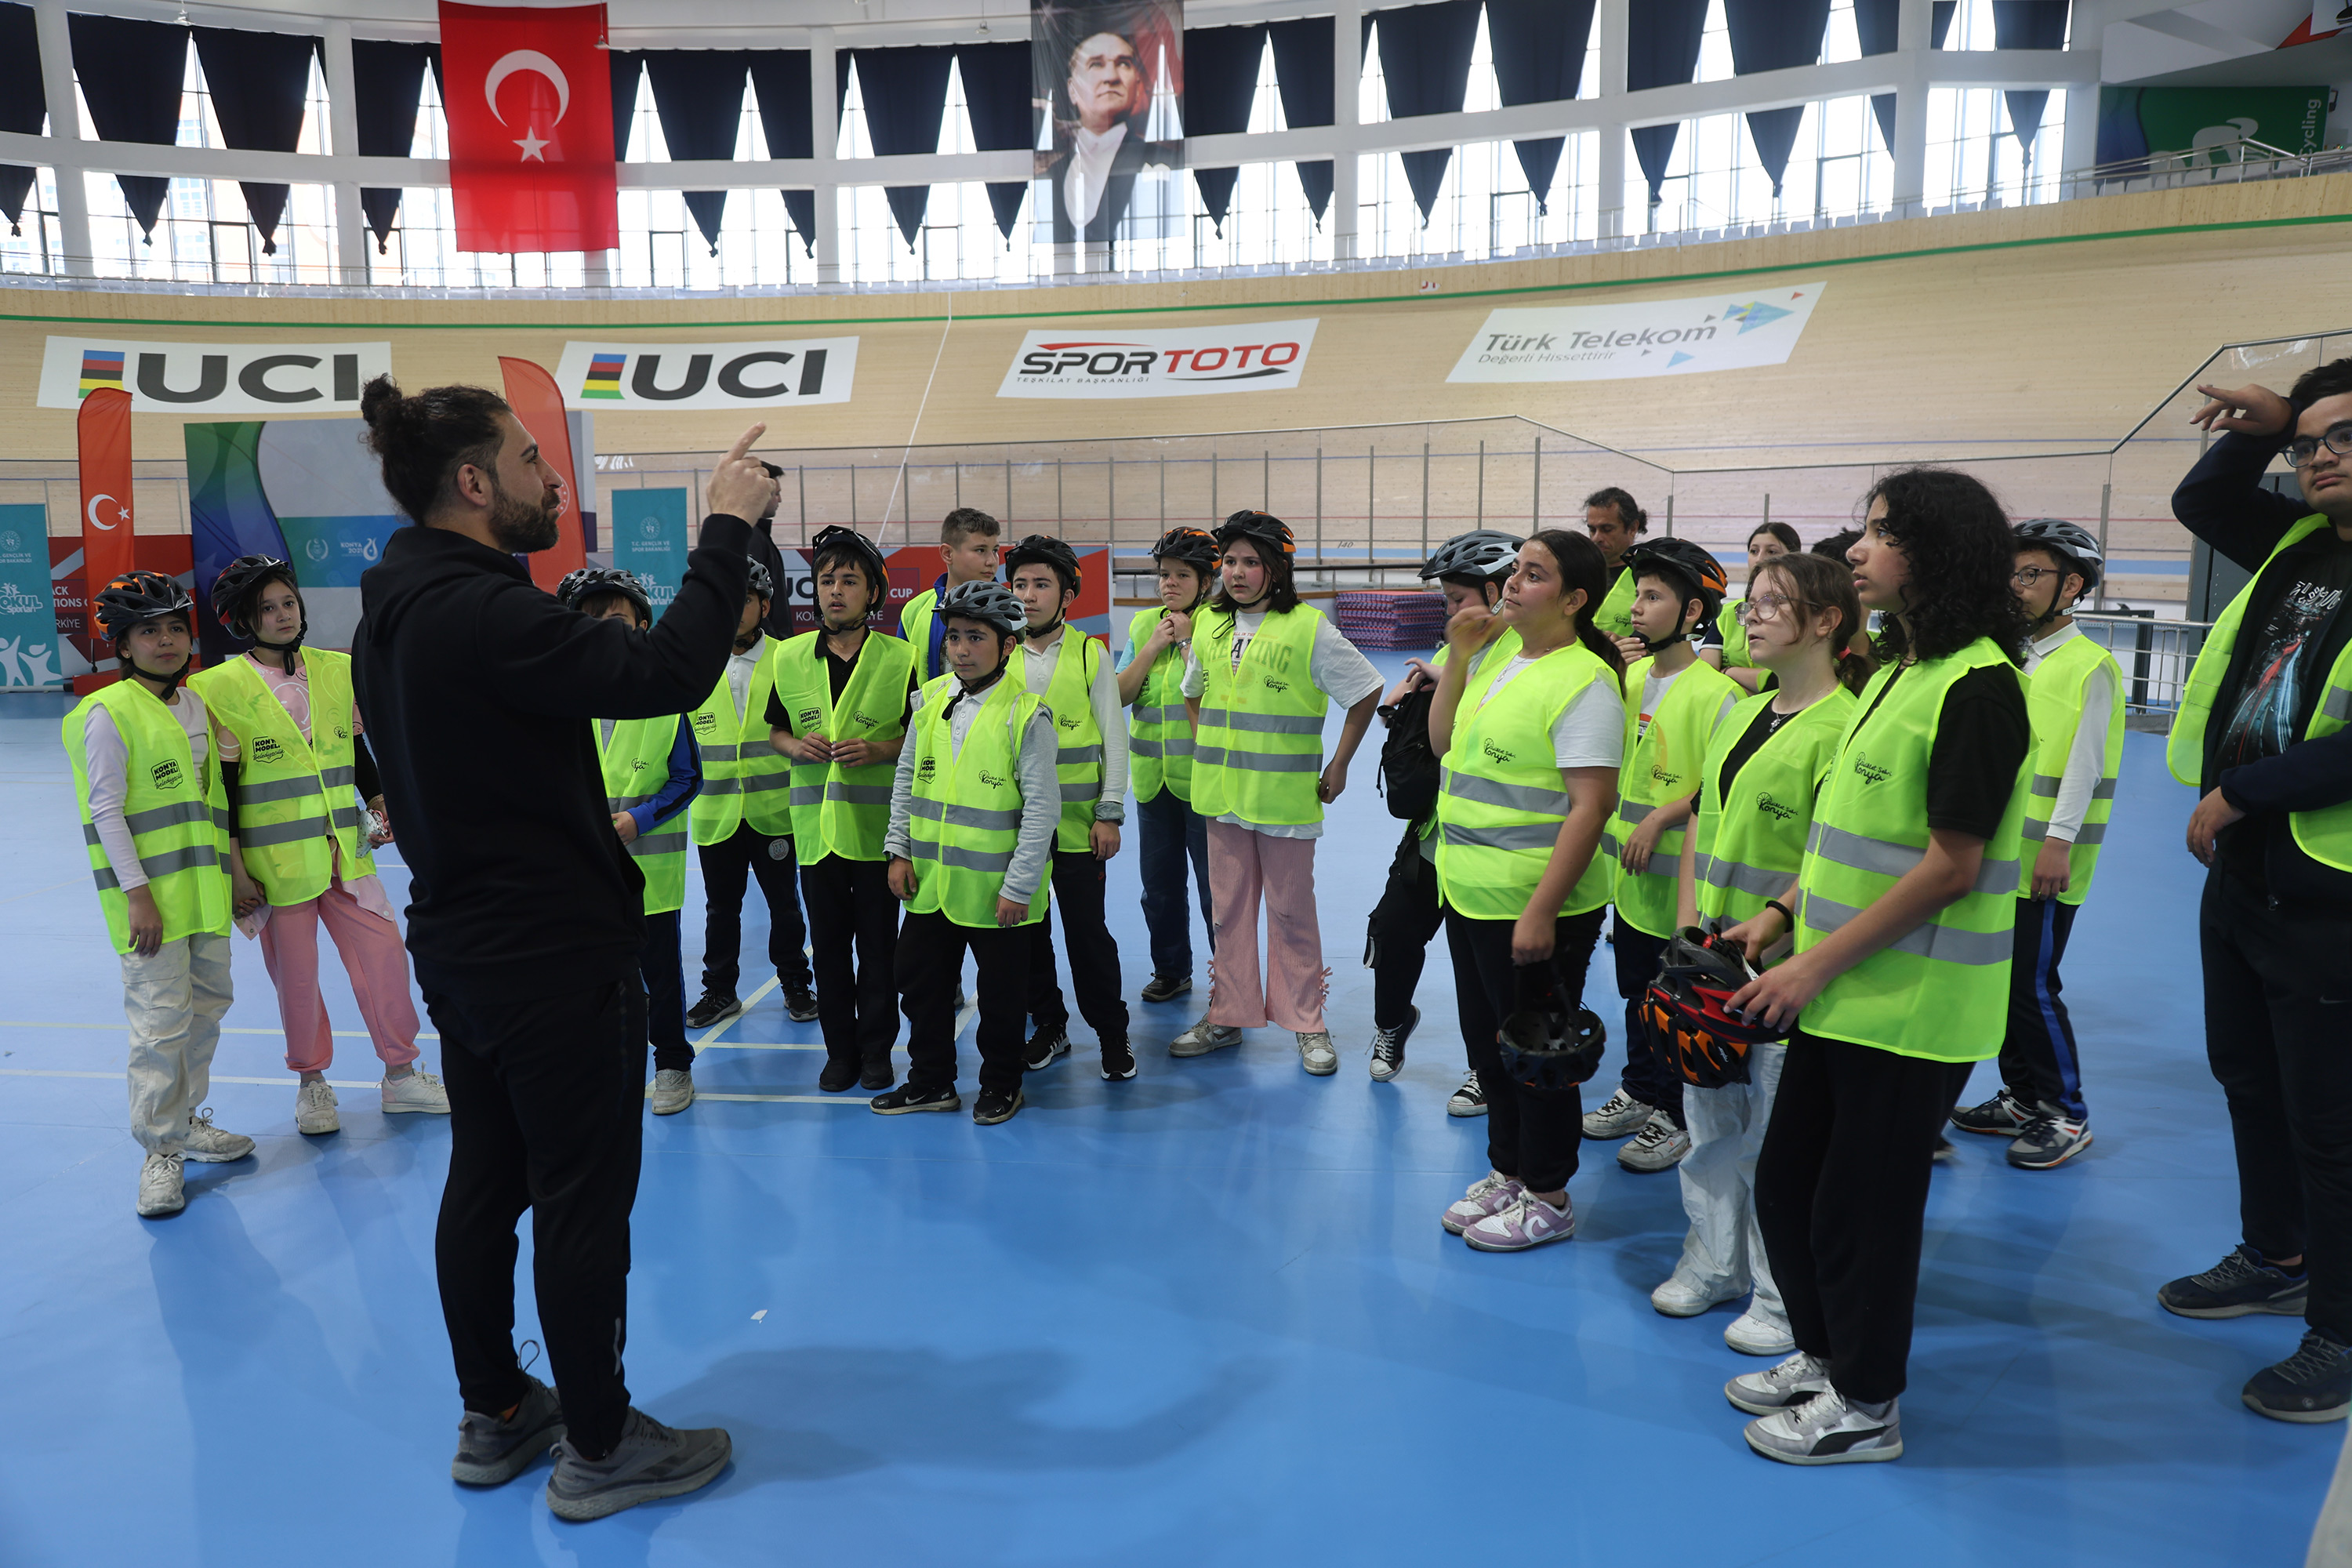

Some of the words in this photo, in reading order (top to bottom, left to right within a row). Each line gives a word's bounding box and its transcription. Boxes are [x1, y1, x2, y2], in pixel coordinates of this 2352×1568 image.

[1485, 332, 1559, 351] Türk
[1569, 325, 1718, 350] Telekom
[1019, 351, 1159, 376] SPOR
[1163, 342, 1301, 373] TOTO
[1478, 353, 1535, 365] Değerli
[1537, 350, 1616, 362] Hissettirir
[137, 352, 358, 403] UCI
[632, 349, 827, 401] UCI
[1076, 376, 1150, 384] BAŞKANLIĞI
[647, 586, 677, 601] KUL
[890, 588, 913, 598] CUP
[0, 595, 43, 609] OKUL
[53, 598, 82, 608] TIONS
[56, 616, 80, 628] RKİYE
[800, 710, 819, 718] KONYA
[255, 739, 276, 747] KONY
[154, 761, 176, 775] KONYA
[1759, 799, 1792, 820] Konya
